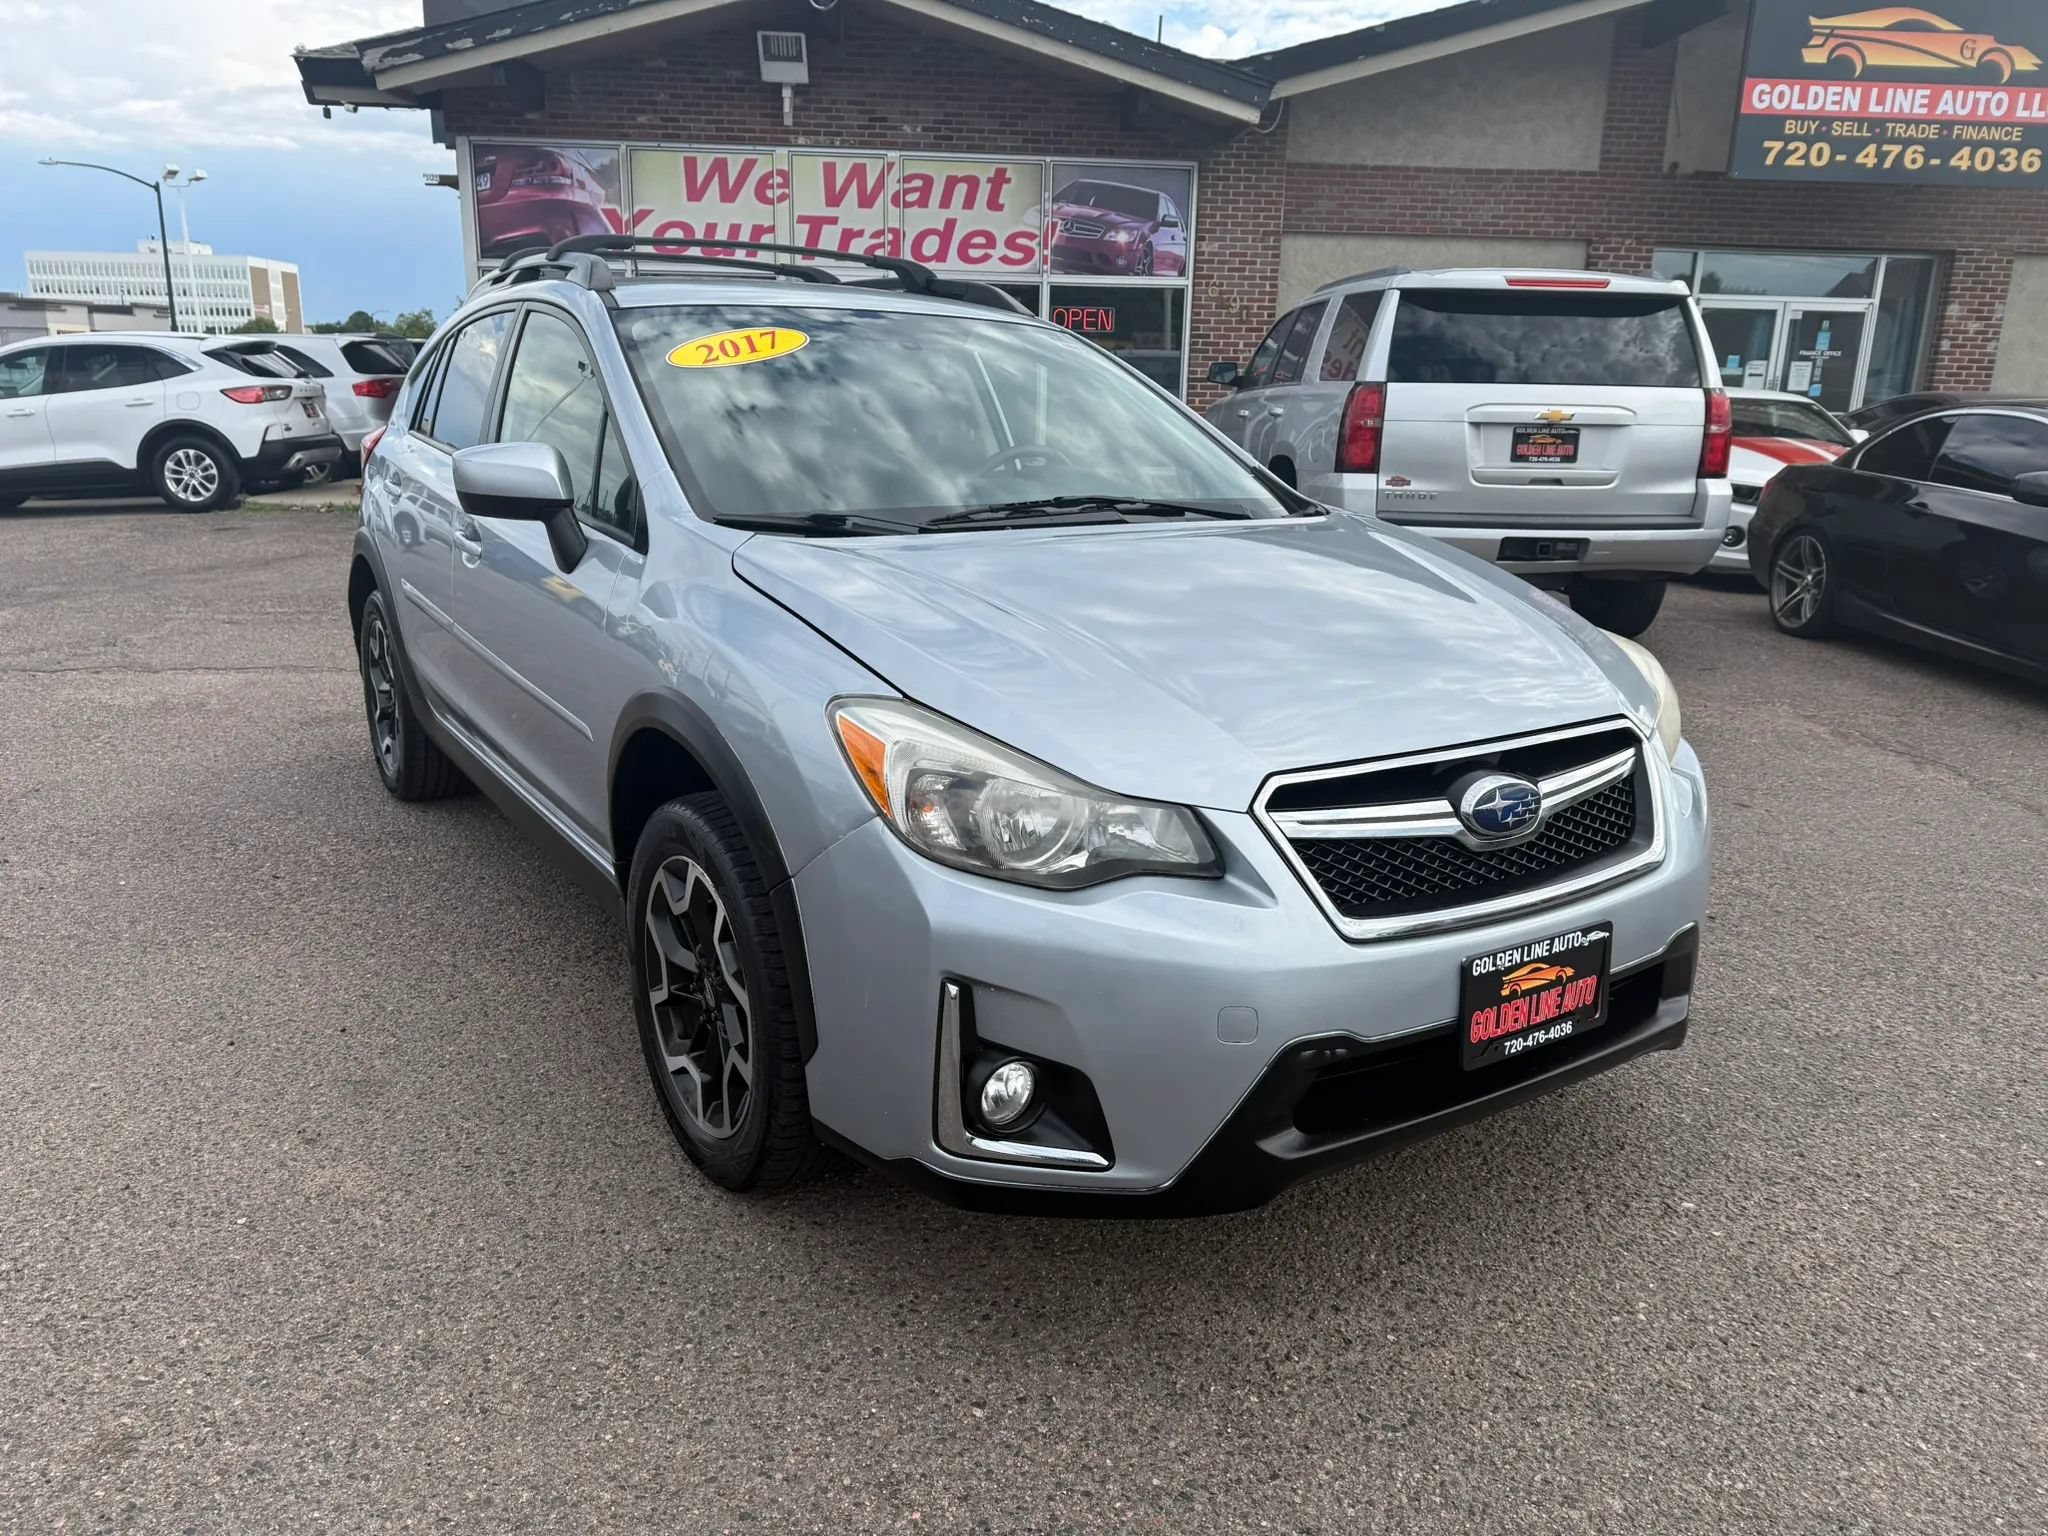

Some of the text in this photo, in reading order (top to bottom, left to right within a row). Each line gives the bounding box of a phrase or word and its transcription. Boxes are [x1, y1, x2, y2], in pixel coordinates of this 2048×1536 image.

[1752, 83, 2048, 118] GOLDEN LINE AUTO LL
[1784, 119, 2024, 141] BUY SELL TRADE FINANCE
[683, 155, 1012, 212] We Want
[601, 207, 1060, 267] Your Trades!
[1053, 308, 1114, 332] OPEN
[695, 330, 776, 364] 2017
[1472, 931, 1582, 976] GOLDEN LINE AUTO
[1470, 975, 1597, 1044] GOLDEN LINE AUTO
[1504, 1021, 1573, 1055] 720-476-4036
